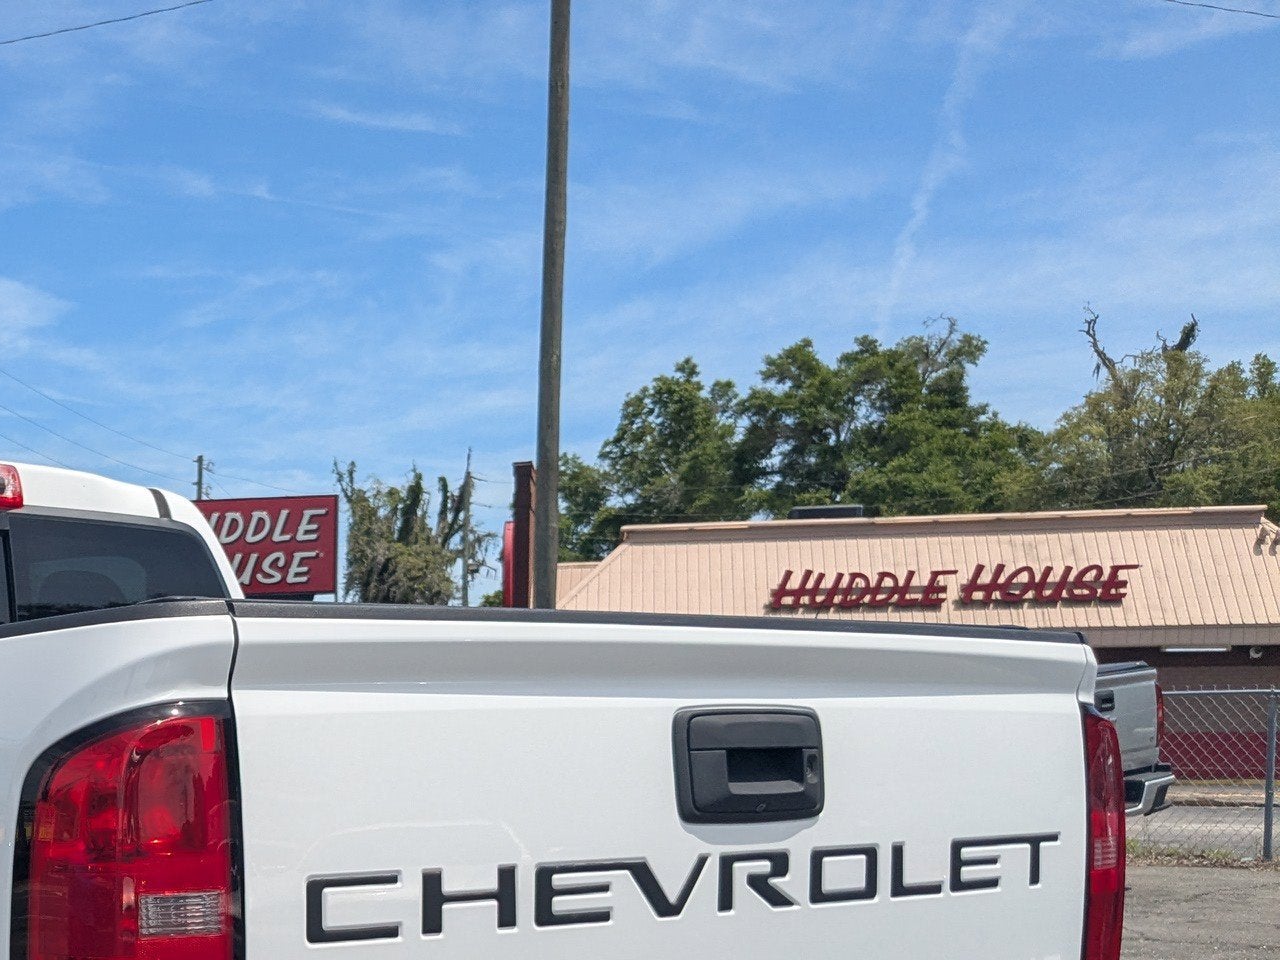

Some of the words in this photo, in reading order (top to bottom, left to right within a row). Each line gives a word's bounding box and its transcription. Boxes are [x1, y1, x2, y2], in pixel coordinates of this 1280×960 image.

[209, 509, 328, 544] DDLE
[232, 551, 318, 585] USE
[771, 569, 959, 609] HUDDLE
[961, 563, 1141, 602] HOUSE
[305, 831, 1061, 944] CHEVROLET
